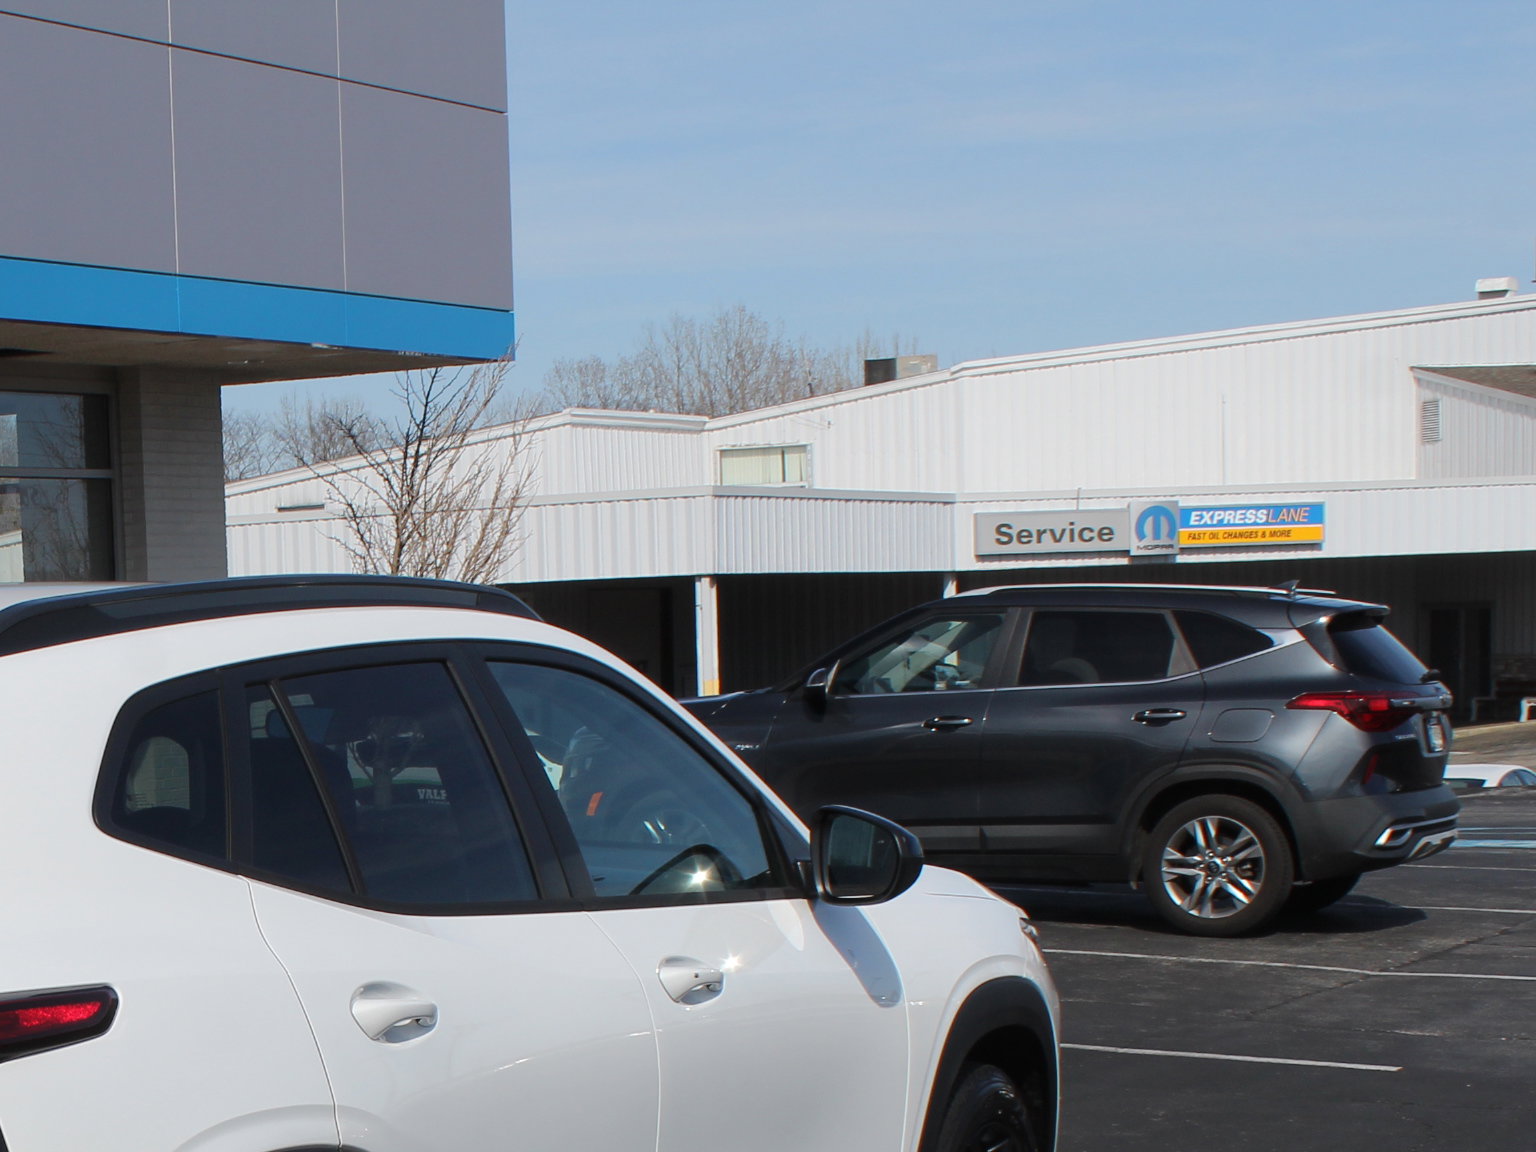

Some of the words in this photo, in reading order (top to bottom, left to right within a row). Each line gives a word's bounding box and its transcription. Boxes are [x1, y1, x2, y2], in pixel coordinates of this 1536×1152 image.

[994, 521, 1115, 546] Service
[1187, 531, 1207, 541] FAST
[1208, 531, 1220, 541] OIL
[1222, 530, 1260, 540] CHANGES
[1269, 529, 1292, 538] MORE
